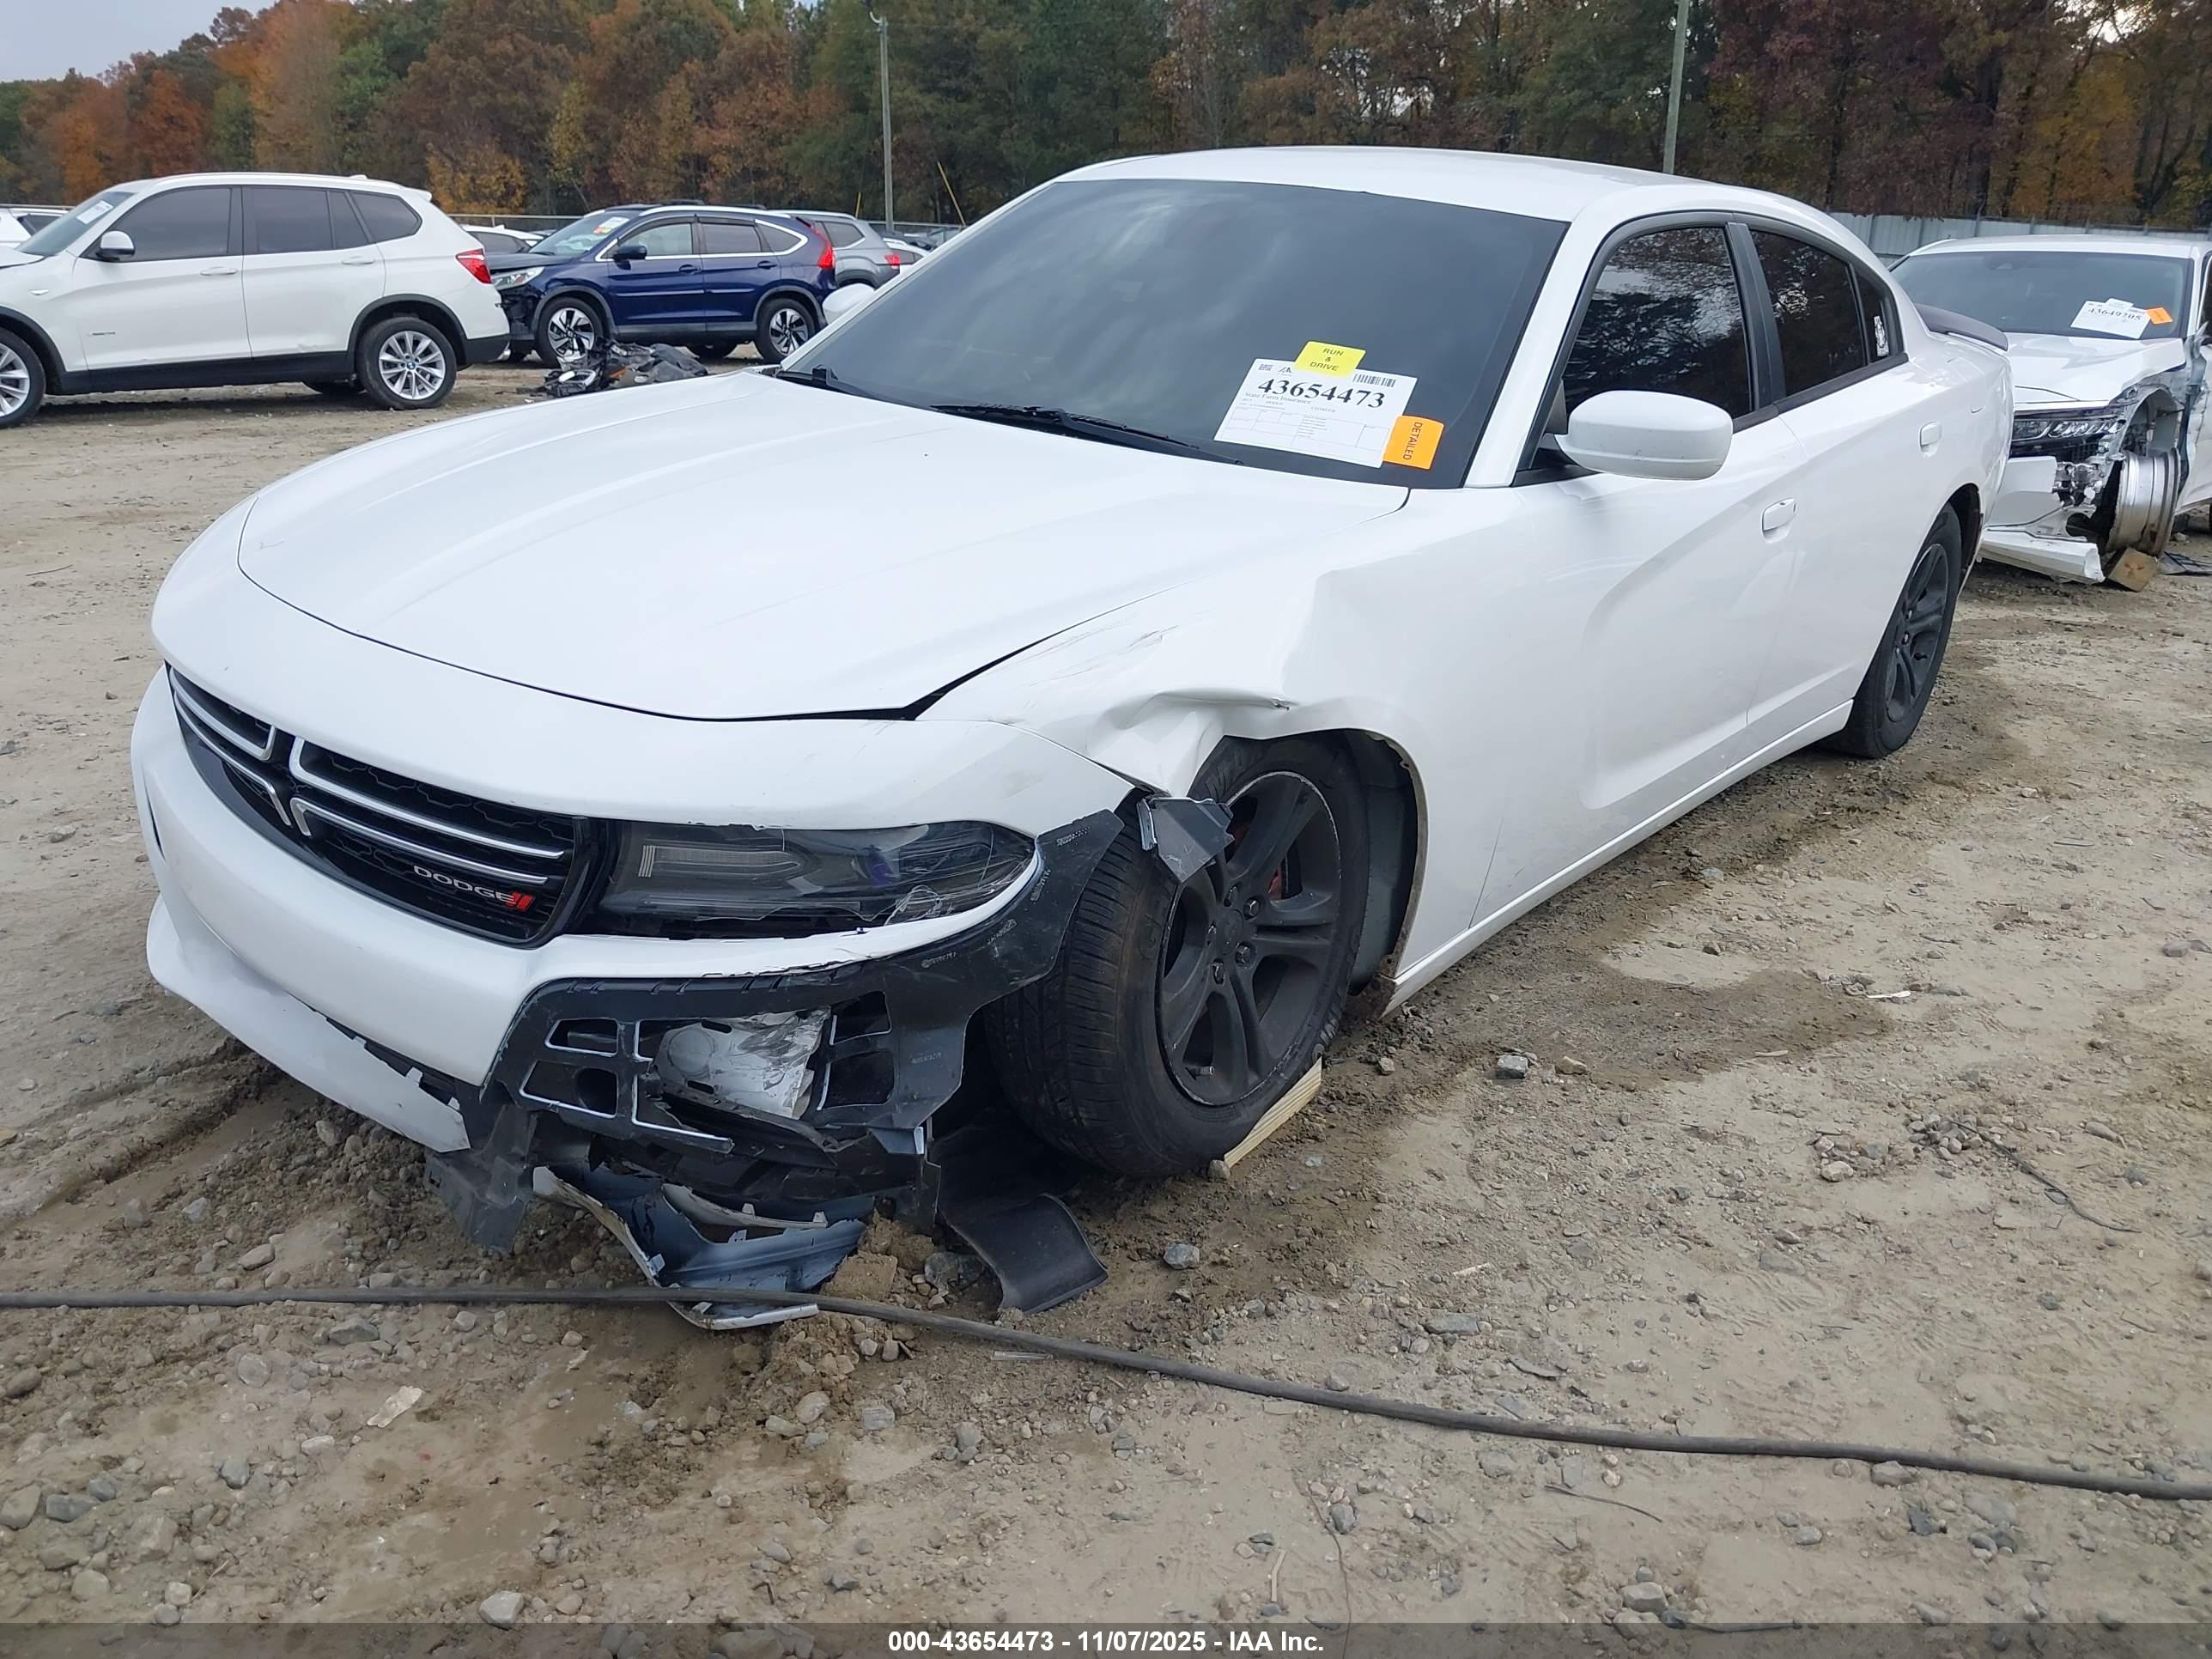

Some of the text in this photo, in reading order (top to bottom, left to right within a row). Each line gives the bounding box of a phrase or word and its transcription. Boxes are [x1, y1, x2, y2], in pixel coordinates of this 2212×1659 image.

[1310, 362, 1340, 372] DRIVE
[1322, 348, 1344, 356] RUN
[1257, 378, 1385, 409] 43654473
[1402, 422, 1423, 460] DETAILED
[413, 865, 517, 905] DODGE
